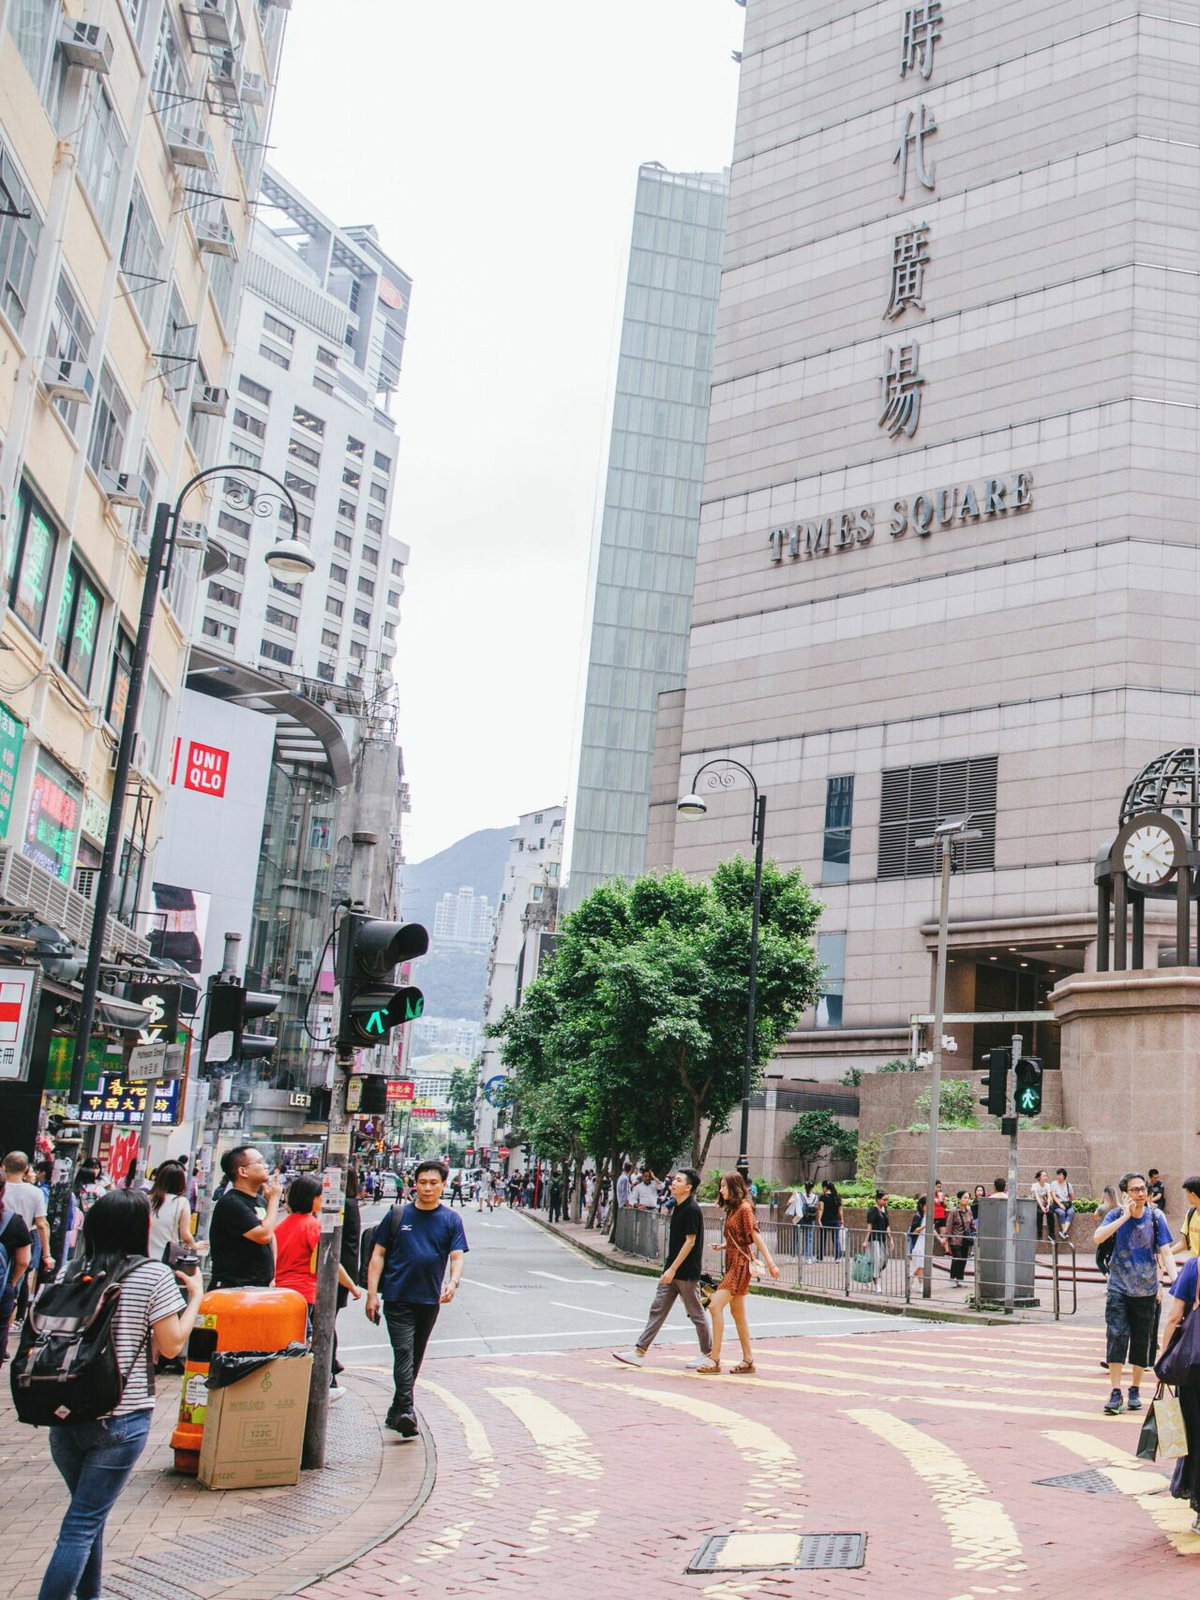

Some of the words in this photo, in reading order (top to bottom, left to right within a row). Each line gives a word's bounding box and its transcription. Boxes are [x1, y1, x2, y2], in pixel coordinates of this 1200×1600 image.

[768, 506, 876, 564] TIMES
[889, 471, 1034, 538] SQUARE
[191, 748, 222, 771] UNI
[189, 768, 222, 790] QLO
[289, 1093, 305, 1107] LEE
